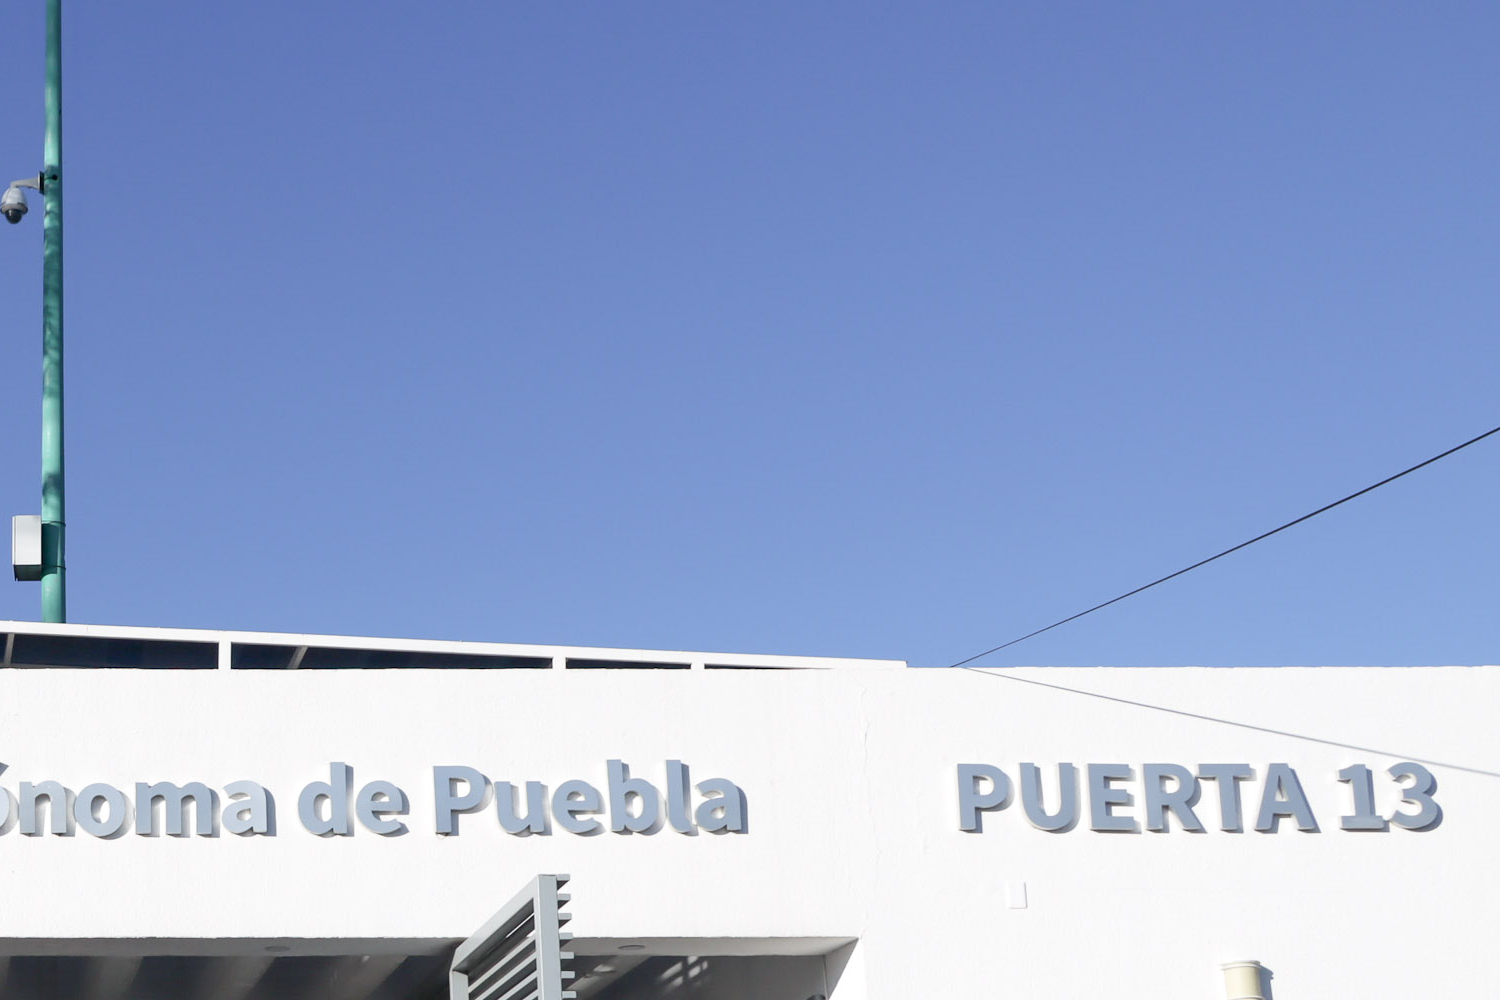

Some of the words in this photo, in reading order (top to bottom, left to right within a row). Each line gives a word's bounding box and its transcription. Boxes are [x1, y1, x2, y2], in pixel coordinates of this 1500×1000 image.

[298, 761, 410, 838] de
[433, 759, 749, 837] Puebla
[957, 762, 1321, 834] PUERTA
[1338, 762, 1444, 833] 13
